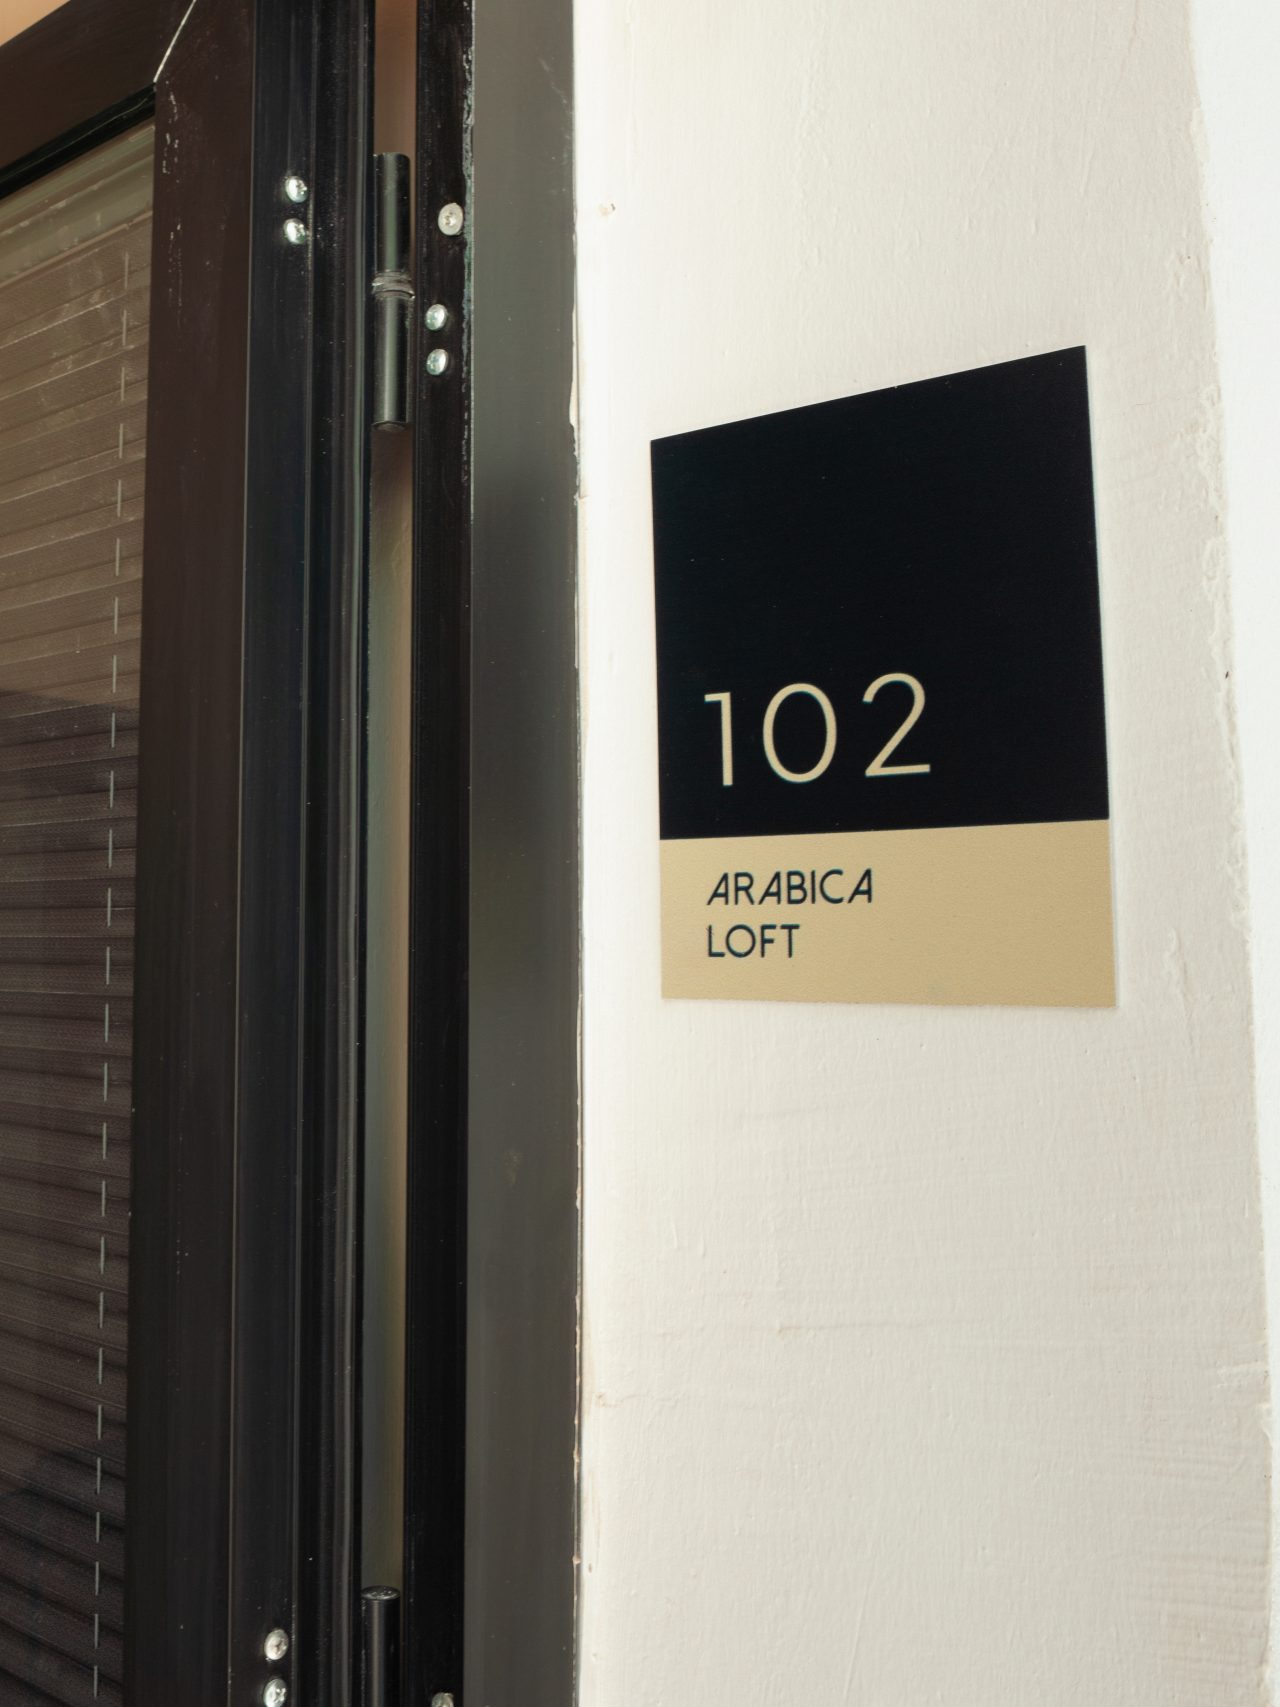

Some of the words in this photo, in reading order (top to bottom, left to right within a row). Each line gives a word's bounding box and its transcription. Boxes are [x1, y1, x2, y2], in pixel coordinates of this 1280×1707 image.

[703, 672, 931, 787] 102
[706, 868, 874, 906] ARABICA
[706, 923, 801, 959] LOFT
